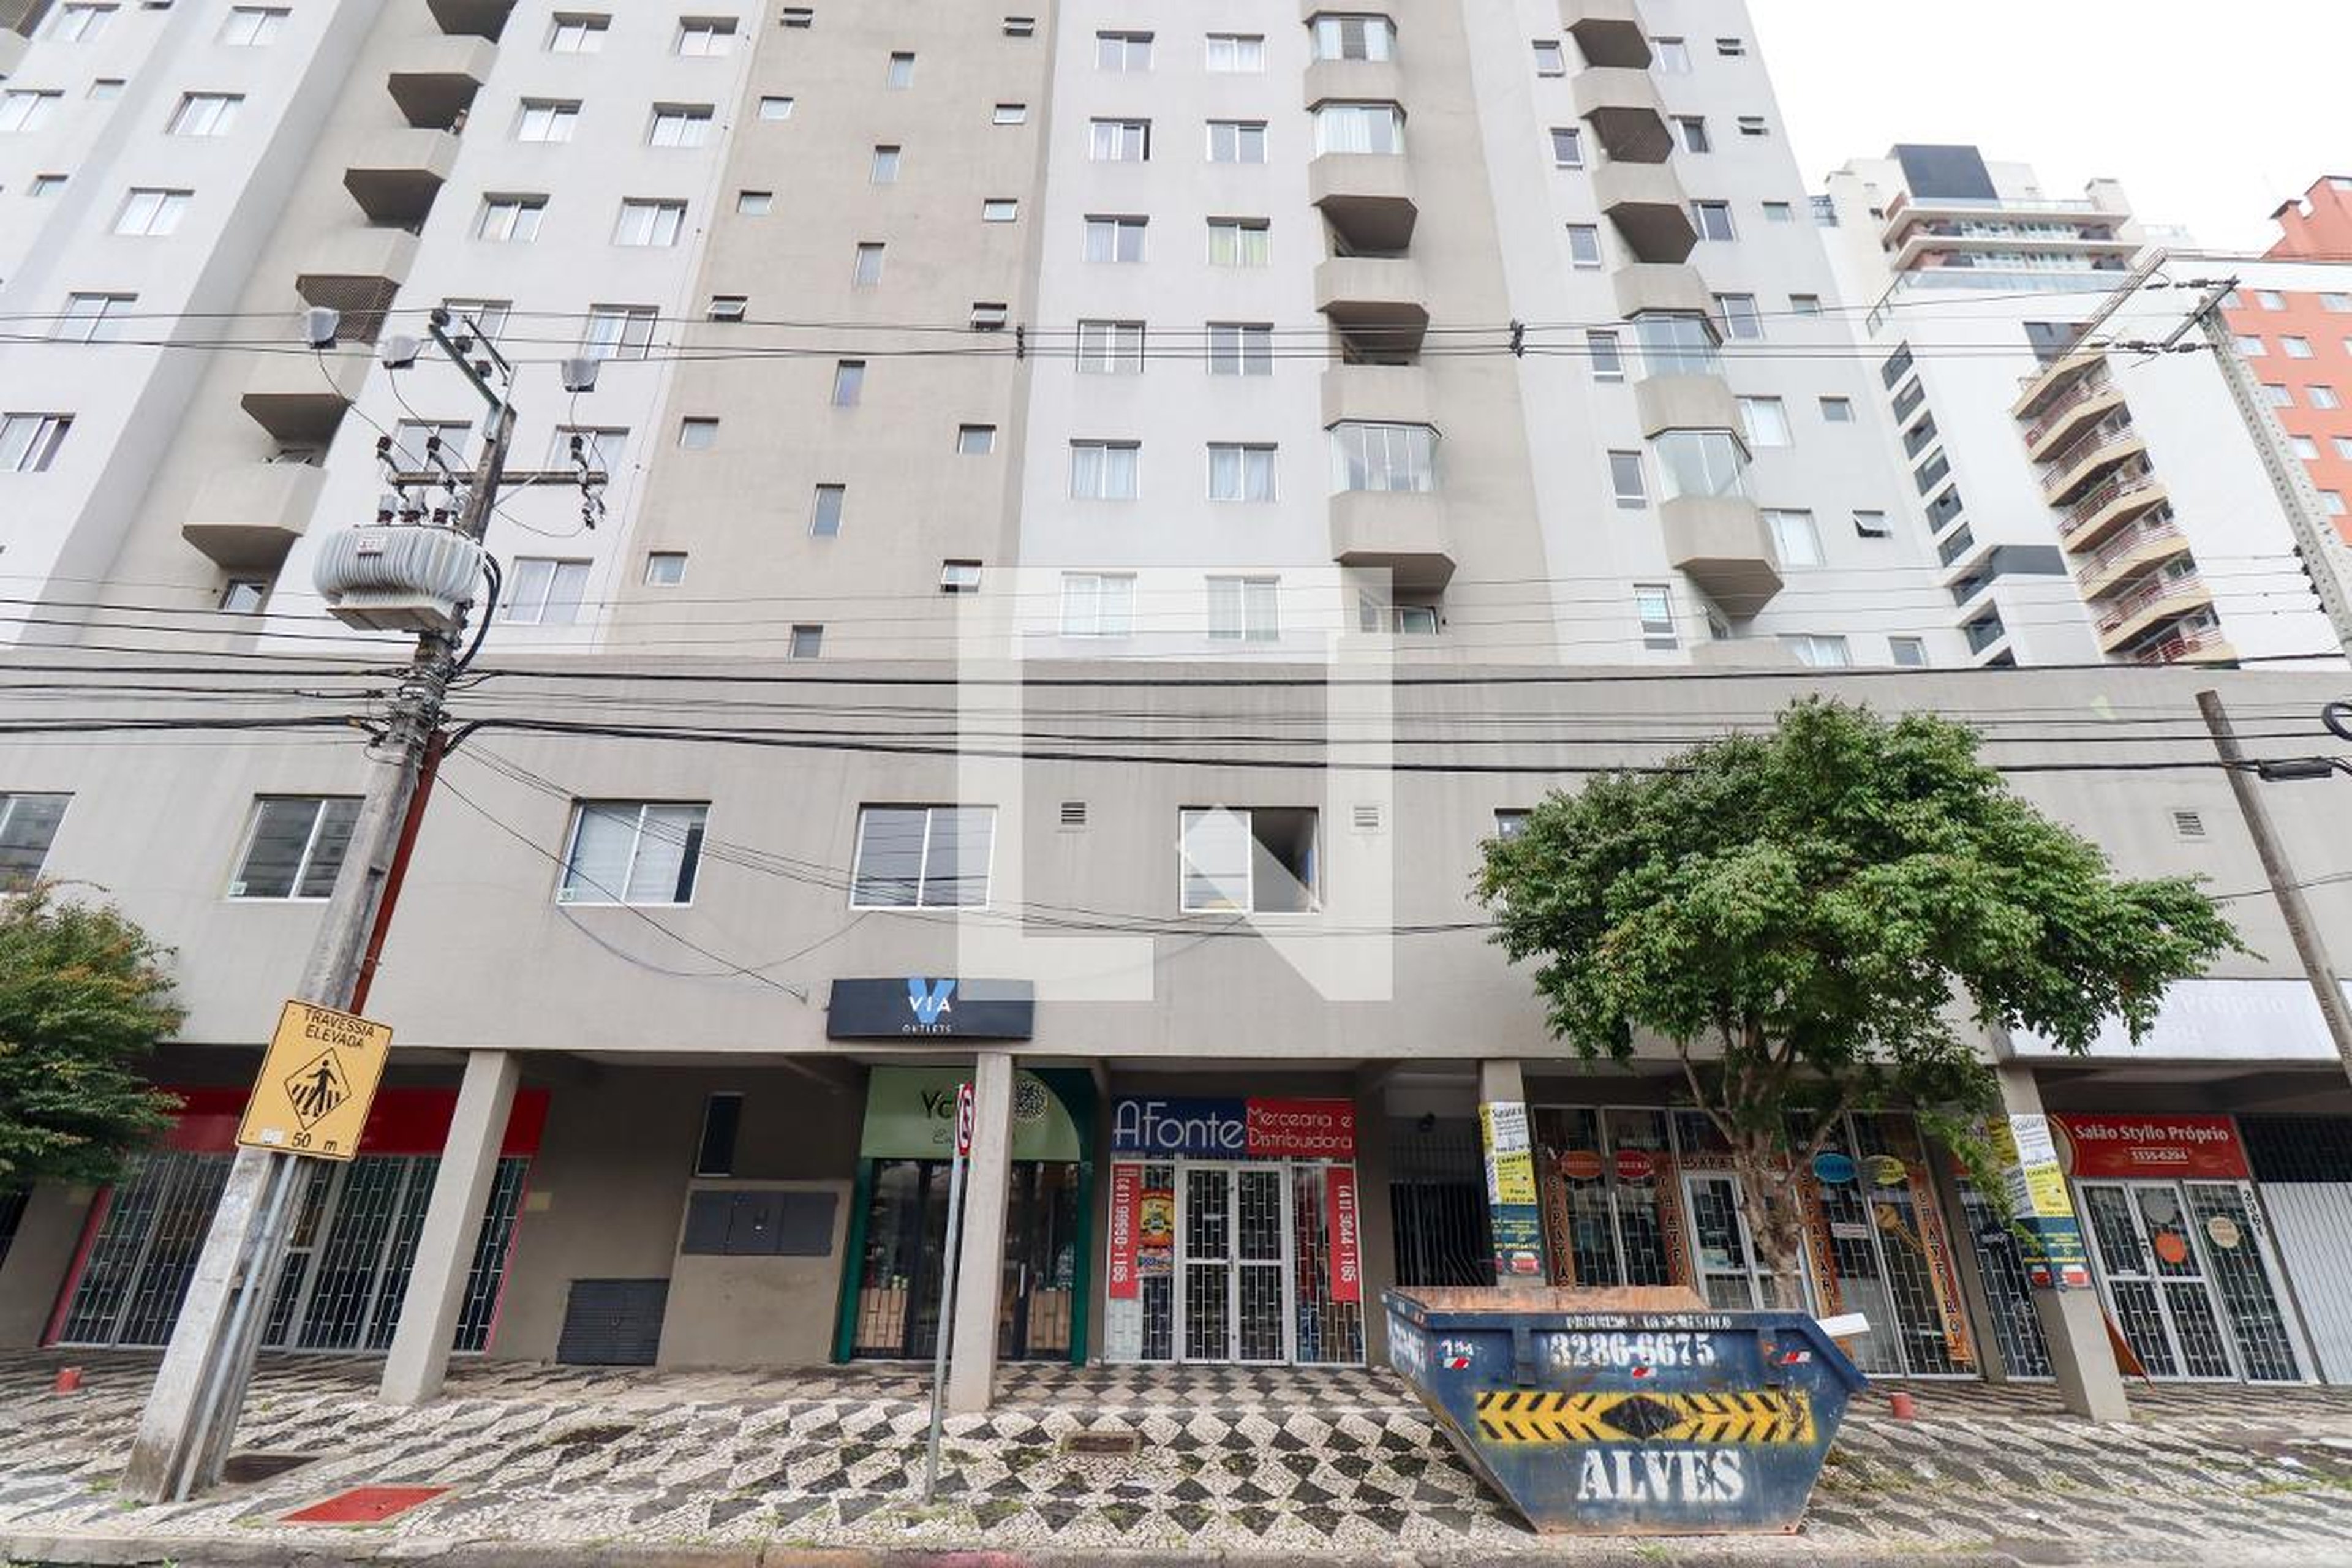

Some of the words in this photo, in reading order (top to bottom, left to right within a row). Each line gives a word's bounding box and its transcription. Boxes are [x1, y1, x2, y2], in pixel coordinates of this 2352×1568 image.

[909, 995, 951, 1012] VIA
[306, 1009, 375, 1038] TRAVESSIA
[306, 1025, 364, 1048] ELEVADA
[1247, 1107, 1332, 1128] Mercearia
[1341, 1115, 1354, 1128] e
[292, 1133, 311, 1148] 50
[324, 1140, 337, 1152] m
[1249, 1128, 1352, 1150] Distribuidora
[2075, 1125, 2118, 1140] Salão
[2119, 1125, 2165, 1144] Styllo
[2168, 1125, 2229, 1144] Próprio
[1577, 1449, 1744, 1503] ALVES
